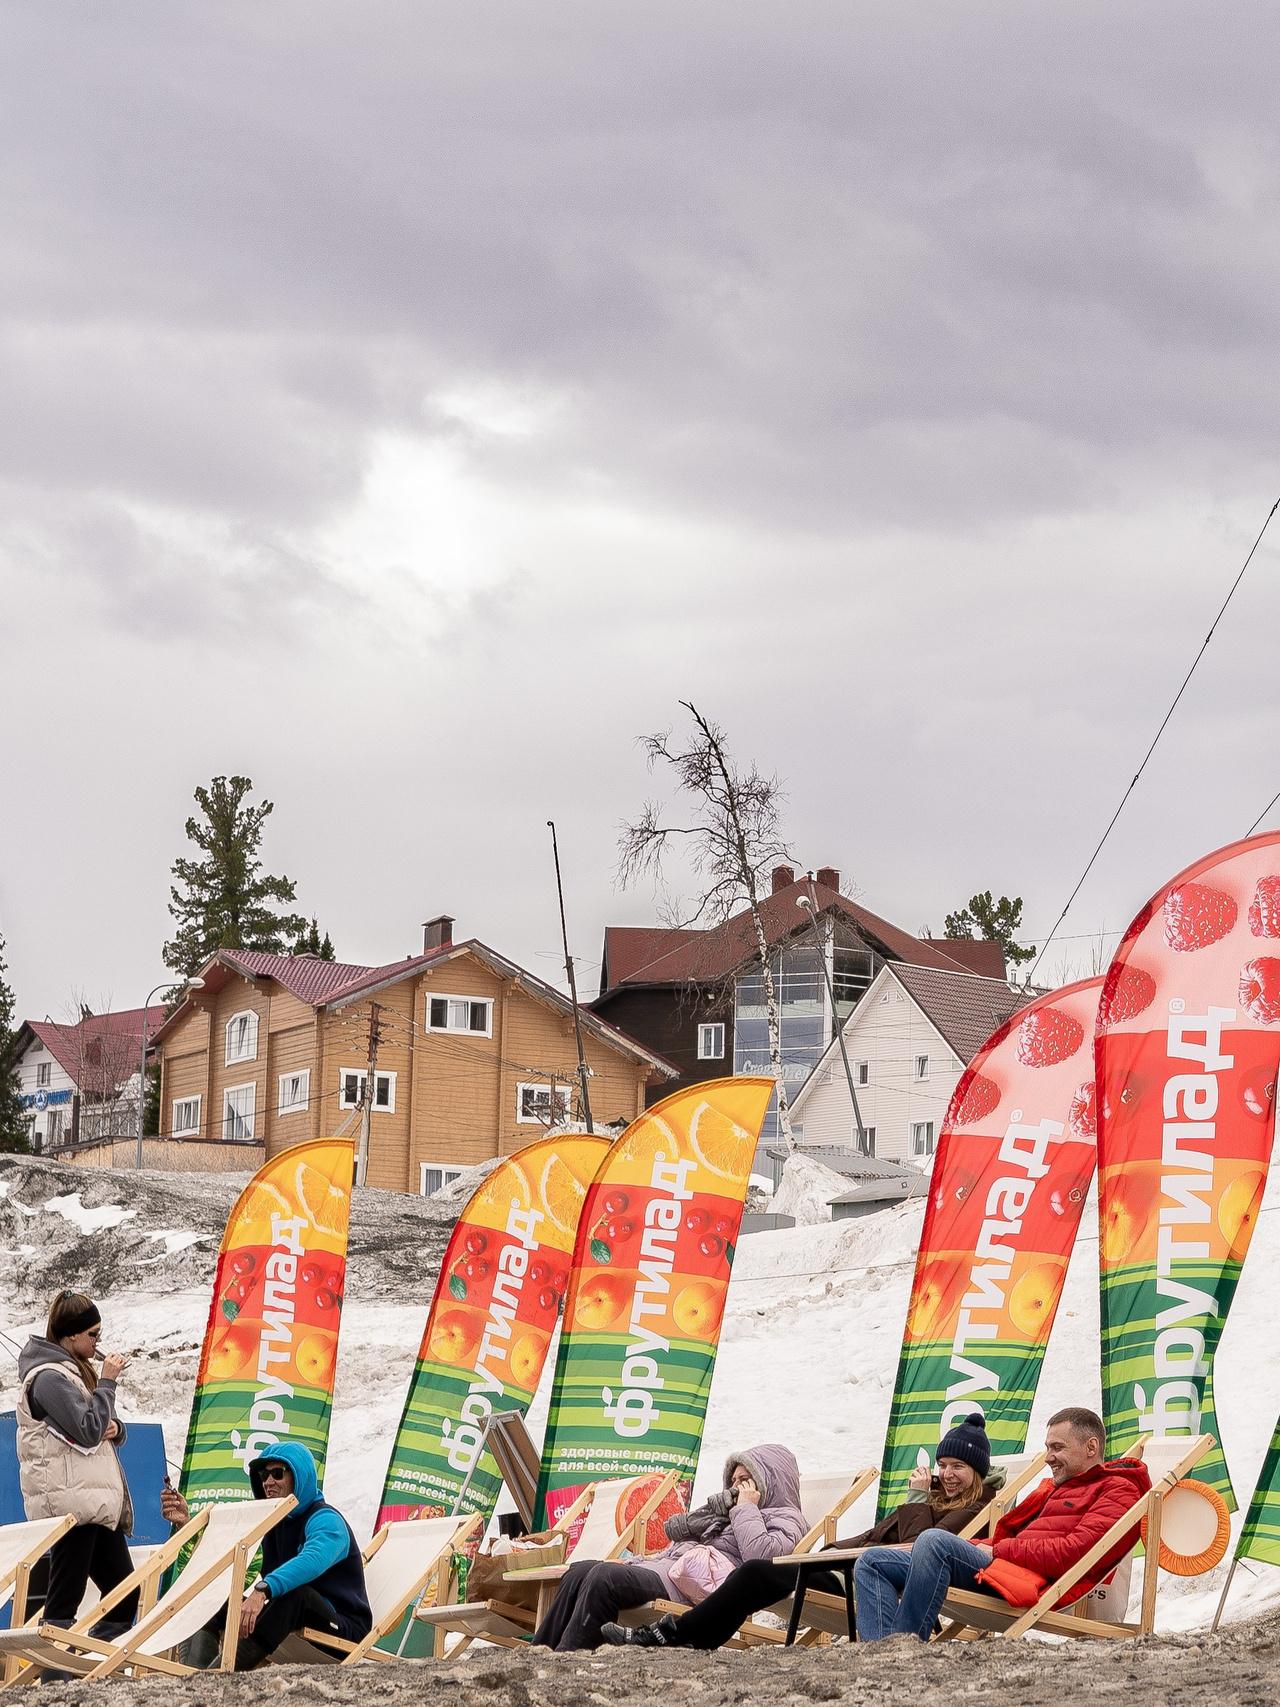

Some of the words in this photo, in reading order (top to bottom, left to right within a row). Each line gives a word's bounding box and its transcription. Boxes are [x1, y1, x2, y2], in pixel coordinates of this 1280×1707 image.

[602, 1156, 699, 1438] фрутилад
[560, 1447, 631, 1460] здоровые
[558, 1461, 584, 1472] для
[587, 1460, 620, 1472] всей
[622, 1463, 664, 1474] семьи
[396, 1467, 458, 1490] здоровые
[192, 1487, 255, 1500] здоровы
[391, 1480, 417, 1493] для
[418, 1485, 447, 1501] всей
